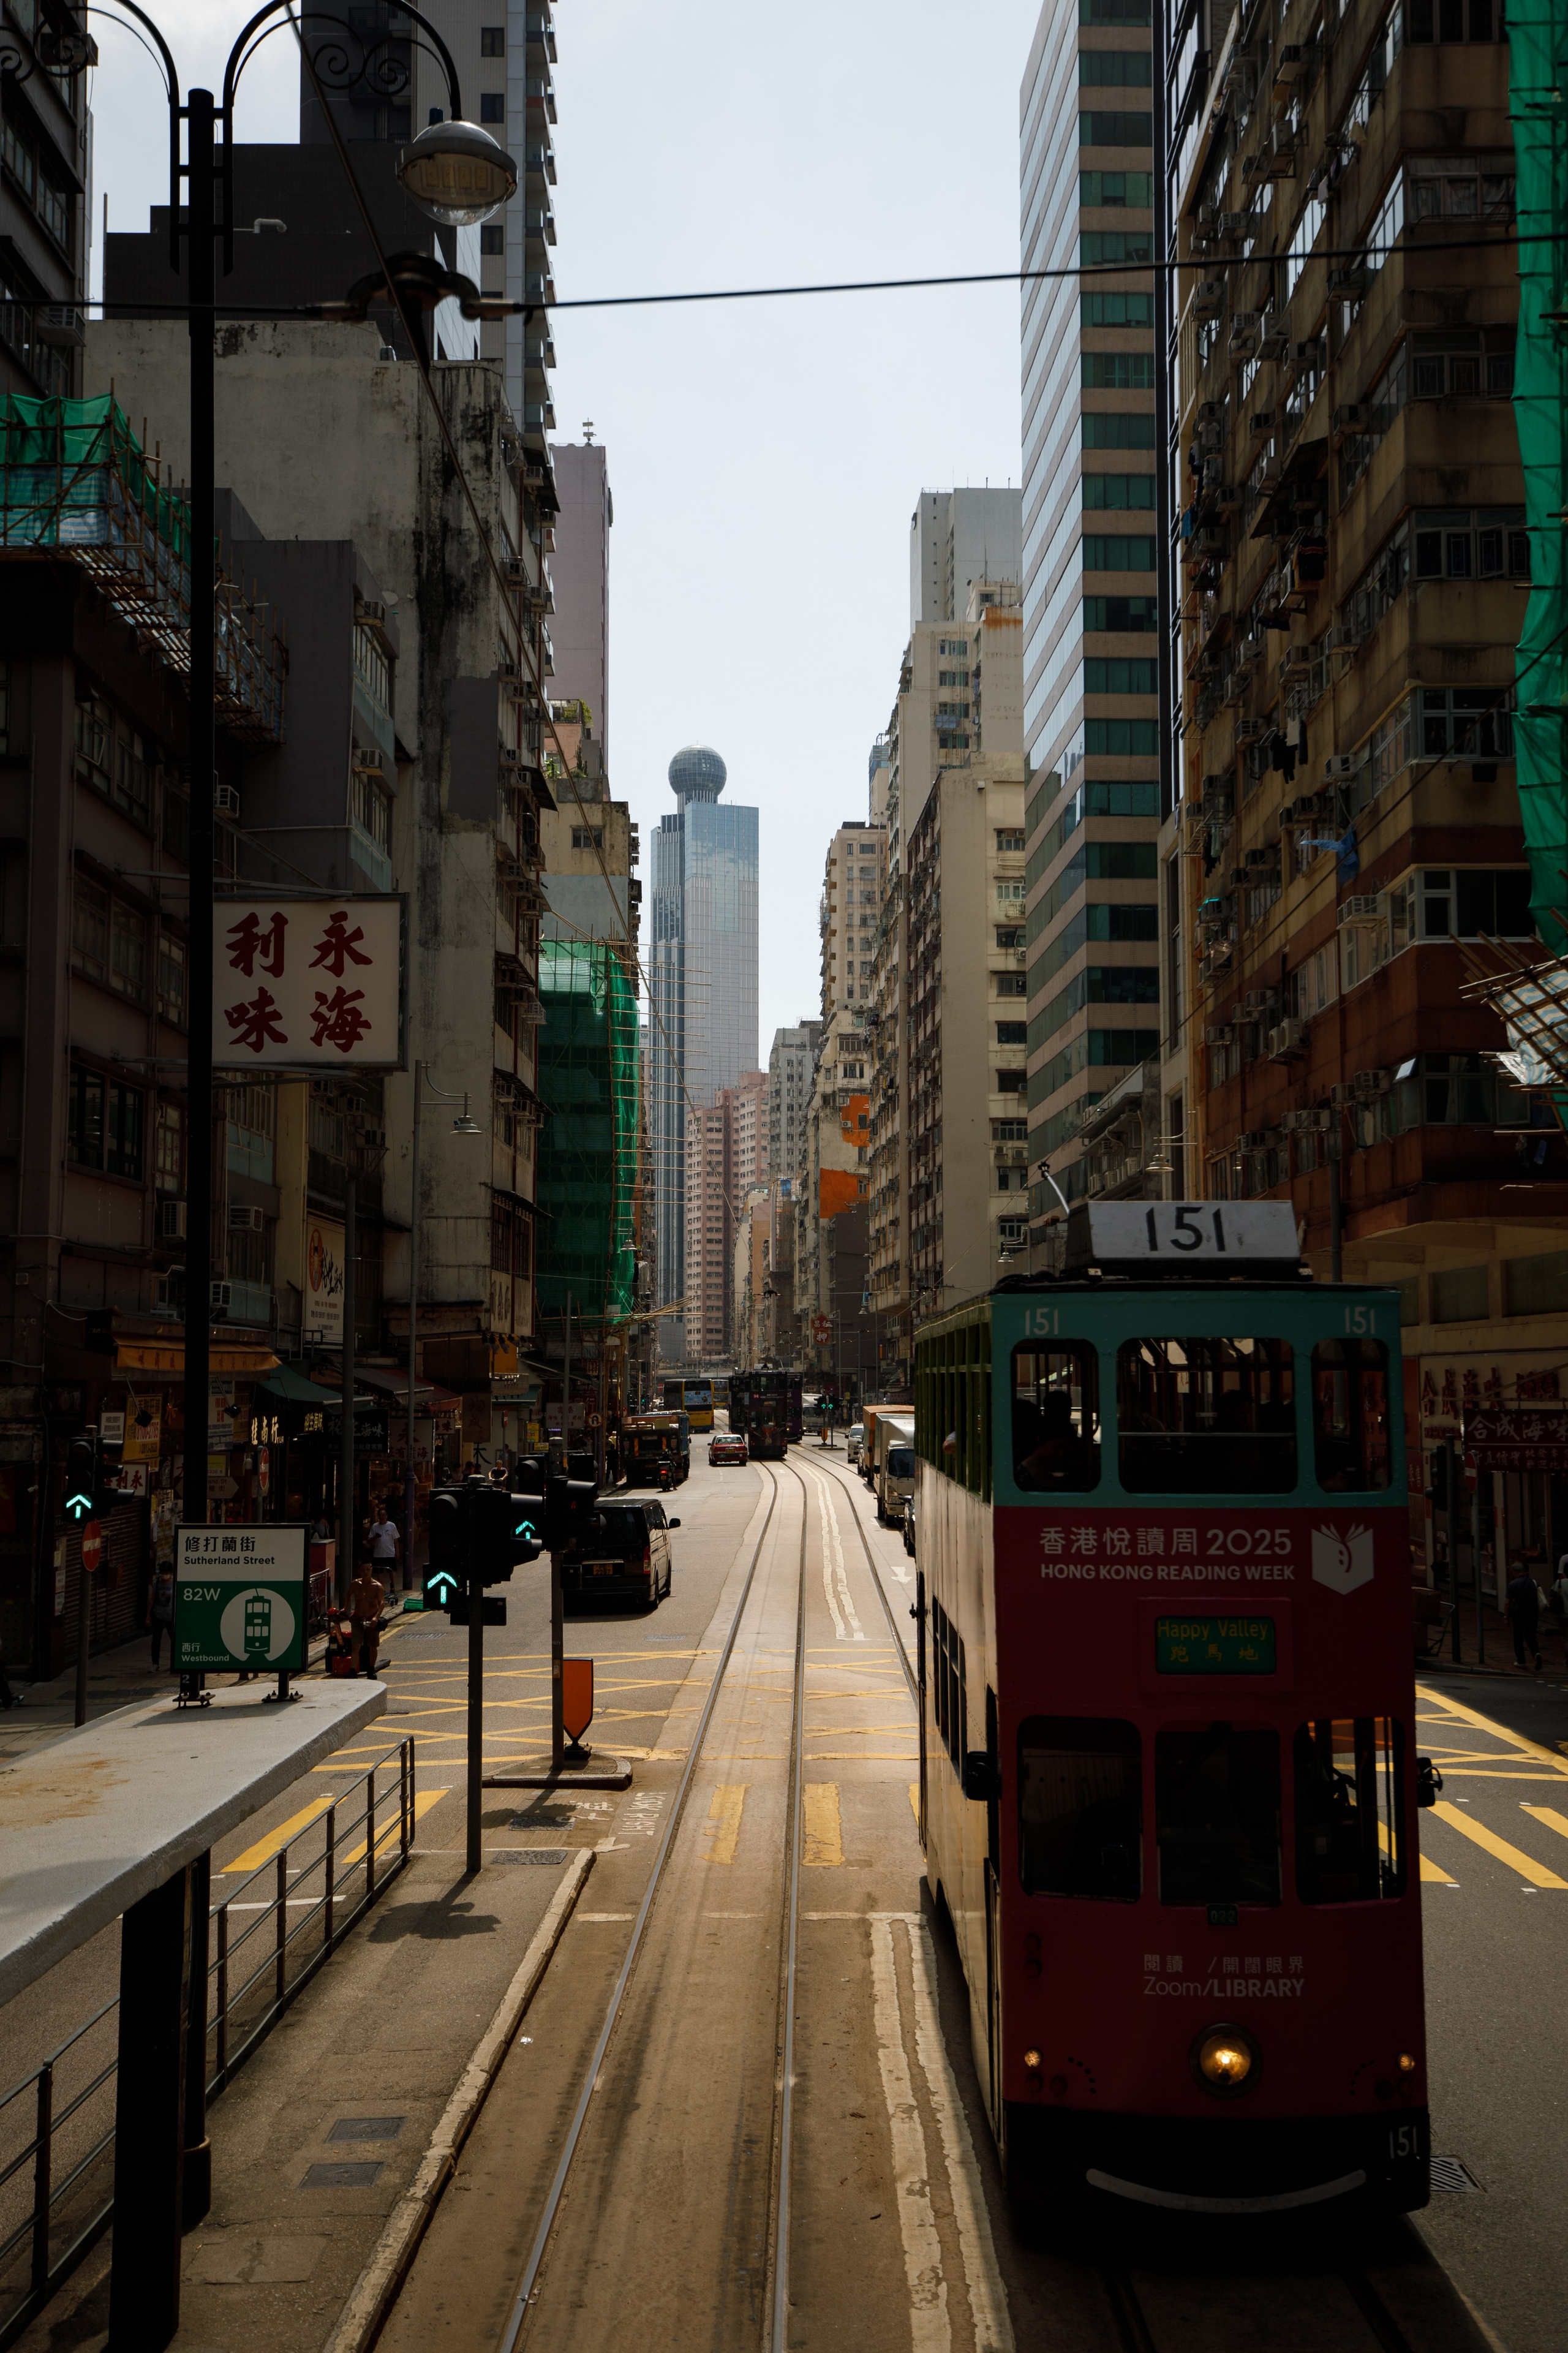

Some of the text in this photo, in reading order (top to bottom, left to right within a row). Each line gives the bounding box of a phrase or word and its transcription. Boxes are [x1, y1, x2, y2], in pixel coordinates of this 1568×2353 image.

[1145, 1206, 1226, 1252] 151
[1024, 1308, 1059, 1335] 151
[1344, 1306, 1376, 1335] 151
[816, 1331, 827, 1343] 押
[185, 1536, 255, 1552] 修打蘭街
[1205, 1528, 1293, 1555] 2025
[1040, 1563, 1295, 1581] HONG KONG READING WEEK
[184, 1588, 221, 1601] 82W
[1157, 1619, 1268, 1641] Happy Valley
[181, 1642, 200, 1653] 西行
[1169, 1643, 1259, 1663] 跑馬地
[617, 1813, 660, 1835] RIGHT
[1210, 1910, 1235, 1923] 022
[1389, 2125, 1418, 2160] 151
